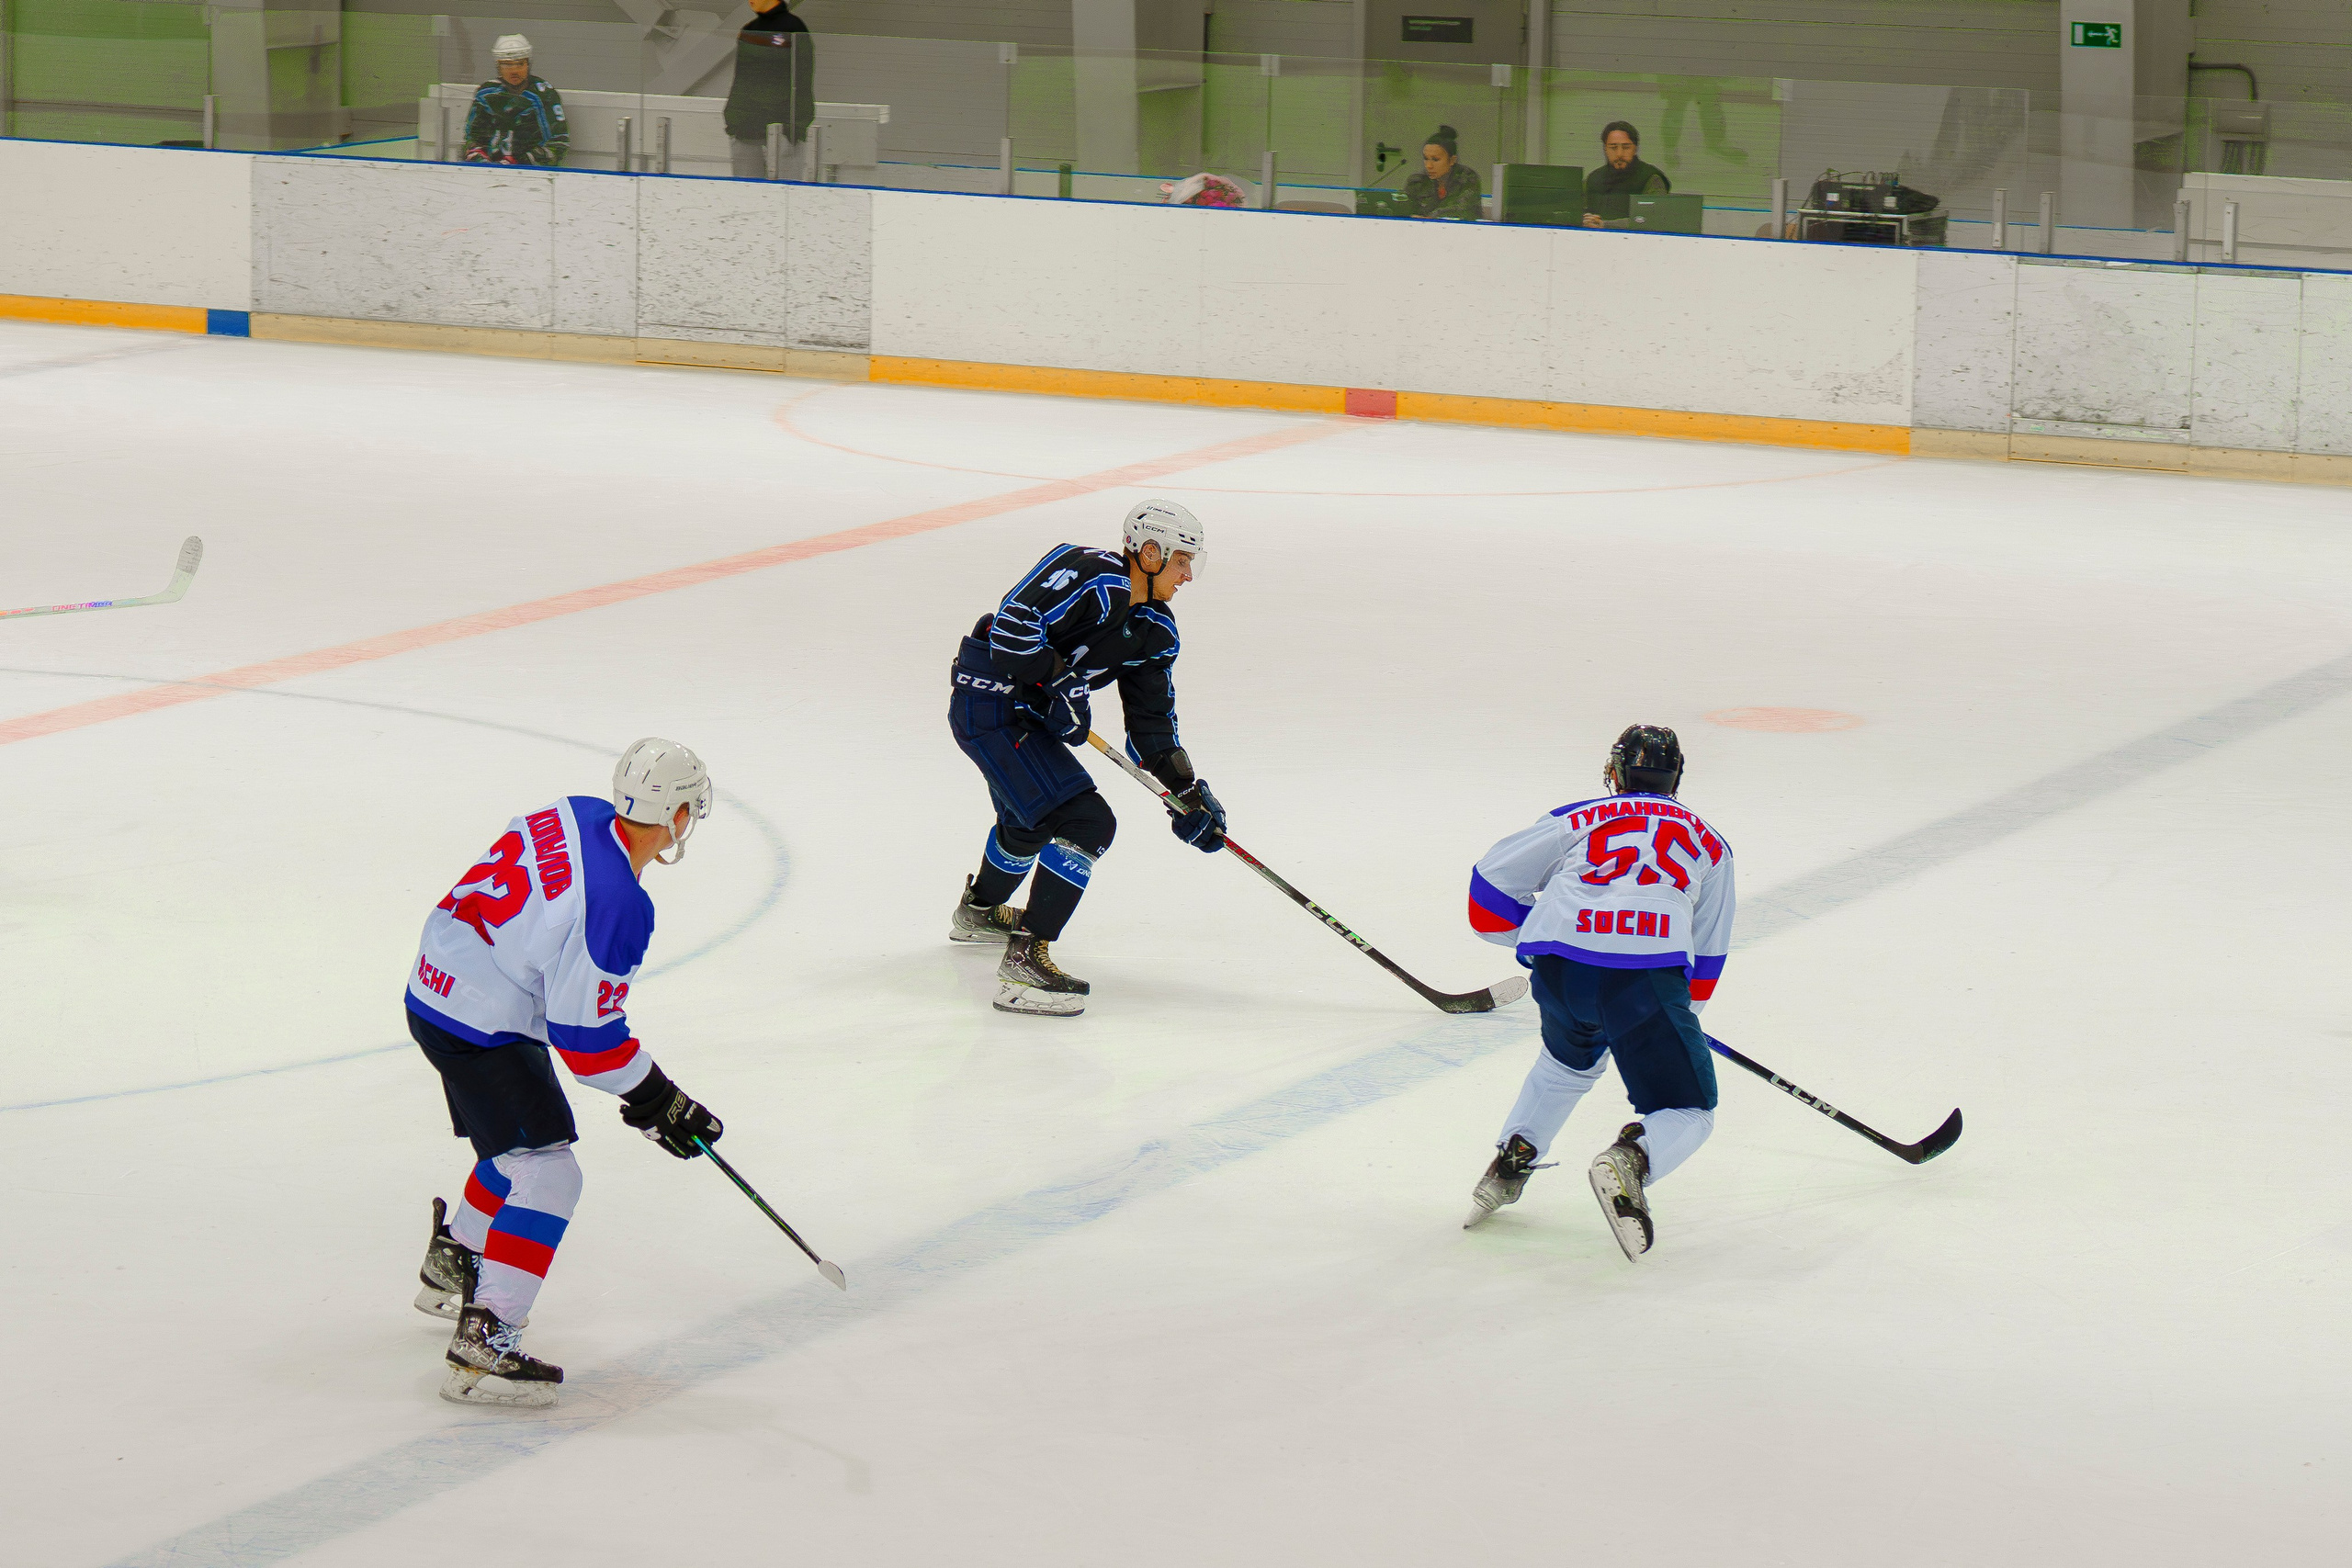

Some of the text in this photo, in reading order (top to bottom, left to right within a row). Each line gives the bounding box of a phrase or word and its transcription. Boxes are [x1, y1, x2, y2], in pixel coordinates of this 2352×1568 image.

[1145, 525, 1165, 534] CCM
[956, 671, 1015, 694] CCM
[625, 795, 635, 816] 7
[1177, 786, 1194, 798] CCM
[1578, 816, 1702, 892] 55
[1306, 901, 1374, 953] CCM
[1576, 908, 1670, 938] SOCHI
[418, 953, 456, 998] CHI
[597, 980, 628, 1019] 22
[1770, 1074, 1839, 1118] CCM
